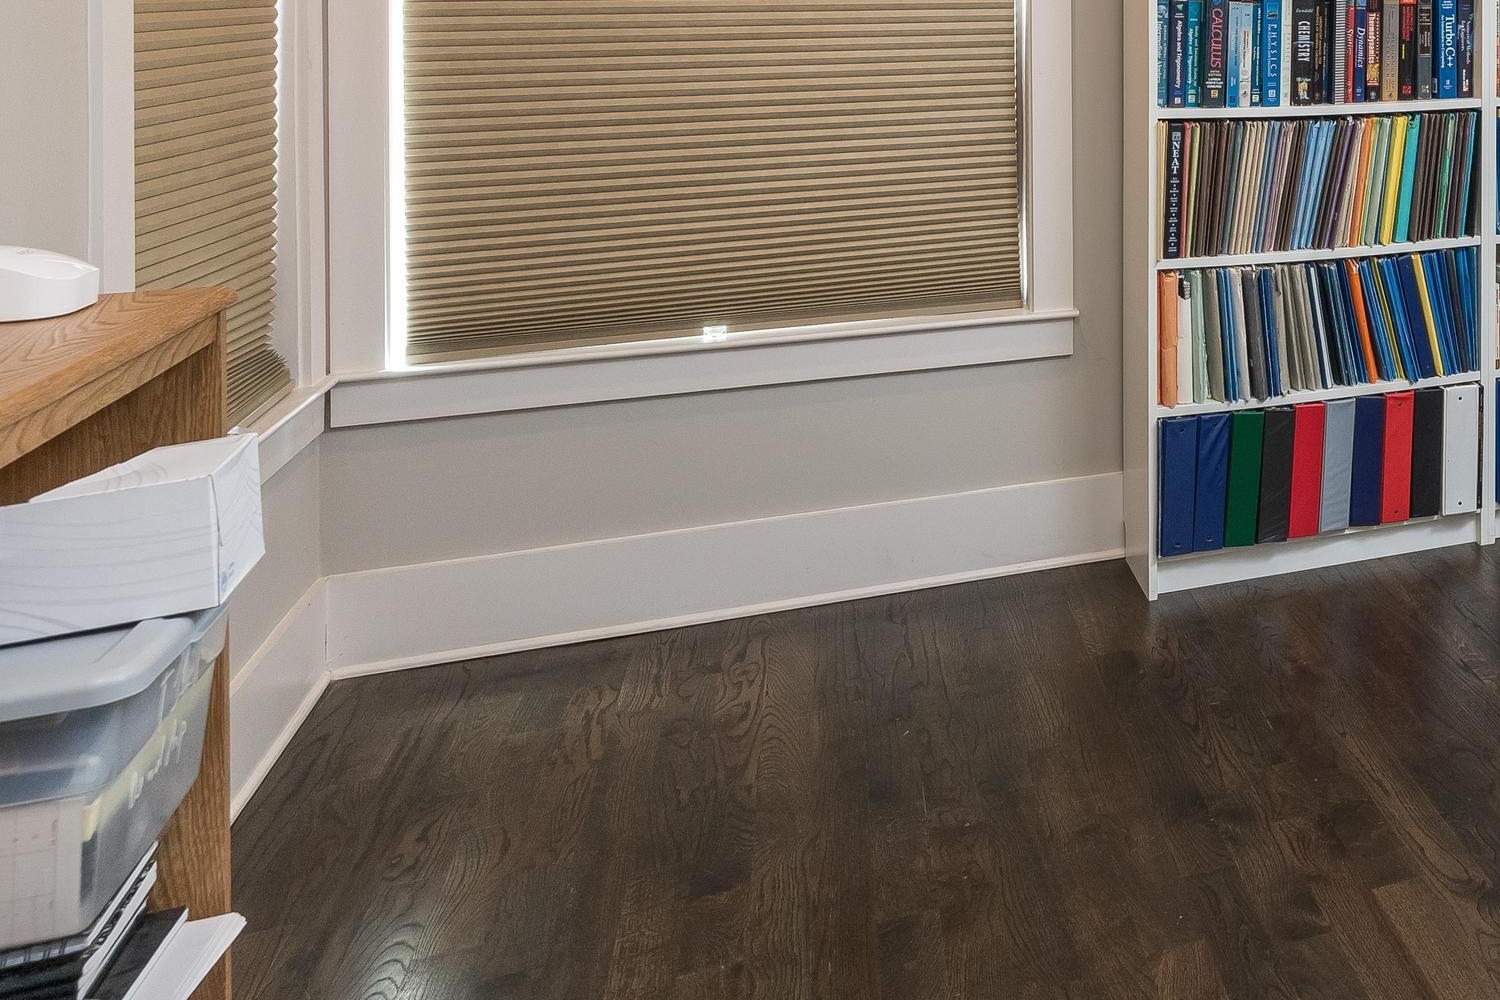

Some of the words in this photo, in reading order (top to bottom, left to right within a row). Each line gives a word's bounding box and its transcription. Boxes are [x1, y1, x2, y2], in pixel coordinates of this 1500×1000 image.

[1211, 8, 1222, 67] CALCULUS
[1295, 21, 1312, 62] CHEMISTRY
[1446, 15, 1454, 45] Turbo
[1357, 27, 1365, 68] Dynamics
[1446, 48, 1454, 67] C++
[1390, 81, 1395, 89] OF
[1172, 142, 1180, 174] NEAT
